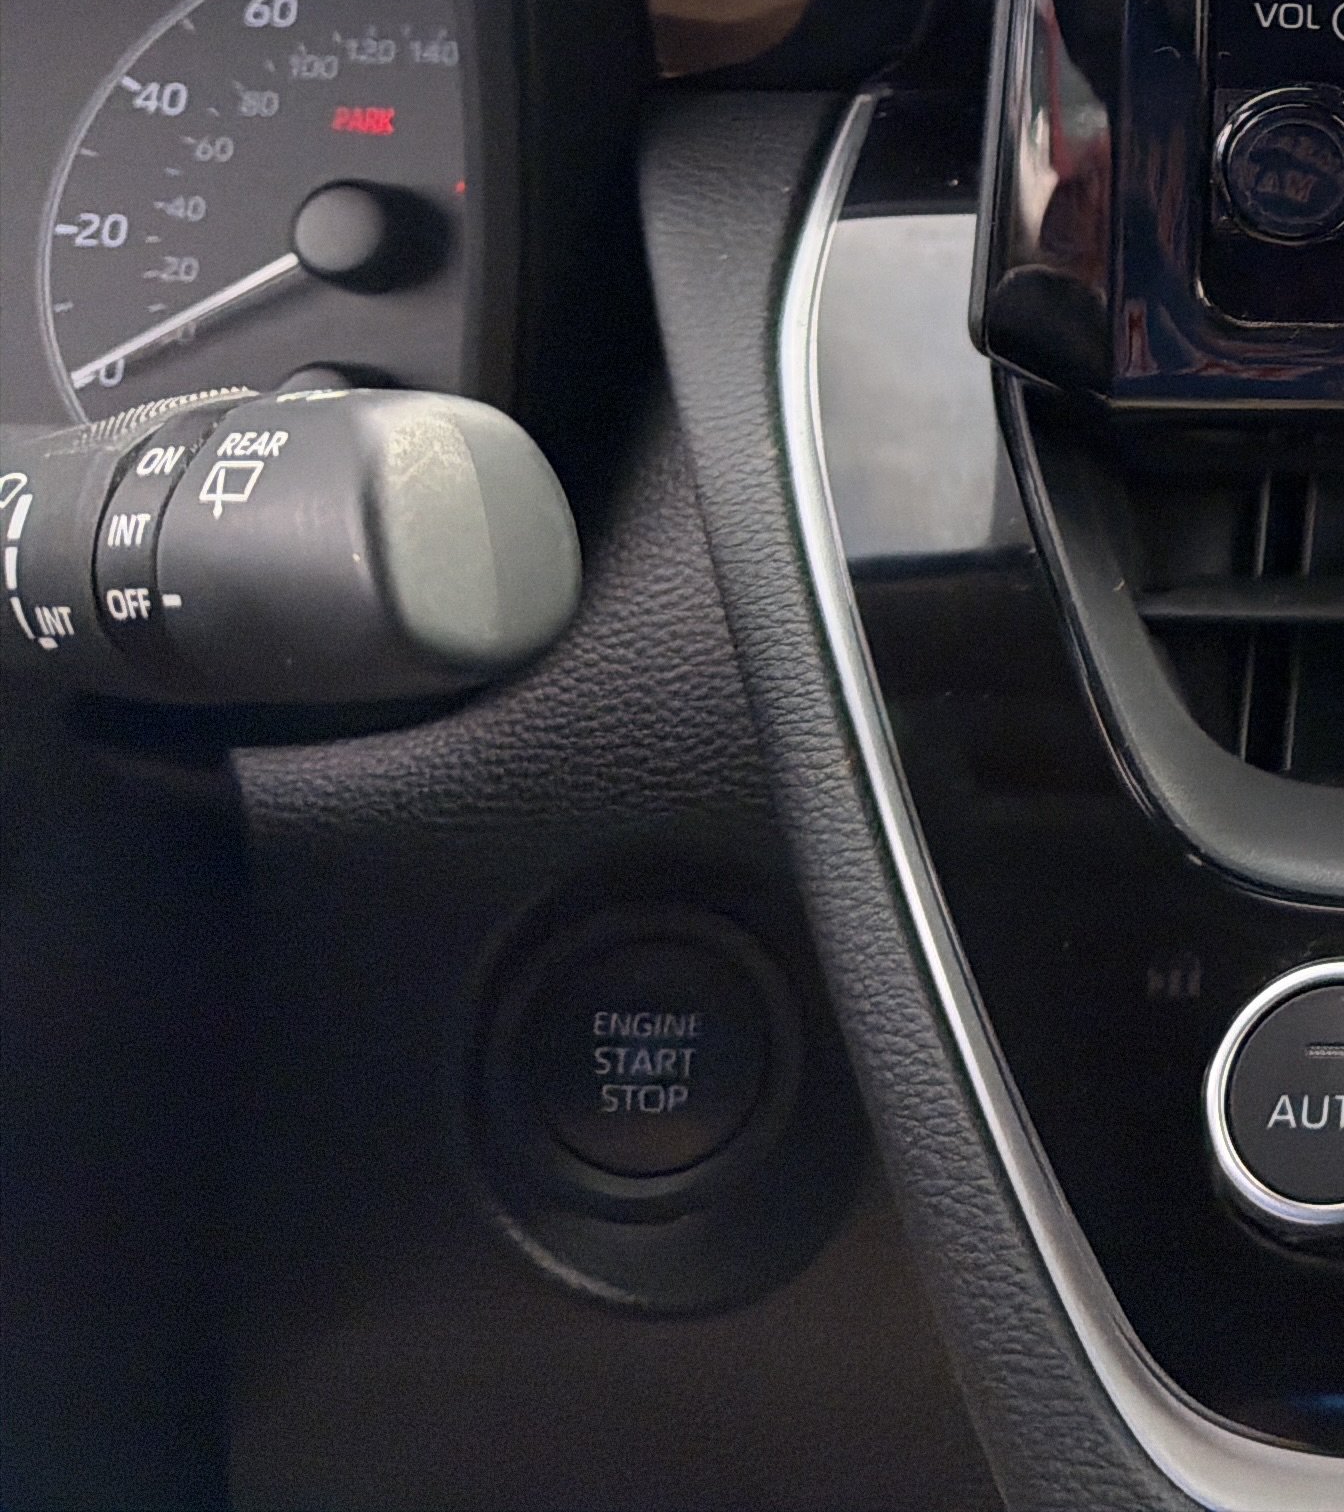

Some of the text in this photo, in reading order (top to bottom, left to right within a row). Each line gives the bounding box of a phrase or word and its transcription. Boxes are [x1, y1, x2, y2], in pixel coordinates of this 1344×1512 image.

[1254, 2, 1320, 30] VOL
[344, 38, 396, 65] 120
[410, 40, 459, 67] 140
[289, 53, 339, 80] 100
[133, 81, 189, 117] 40
[331, 106, 395, 135] PARK
[194, 136, 235, 163] 60
[163, 194, 207, 222] 40
[73, 212, 129, 248] 20
[160, 255, 200, 283] 20
[217, 431, 289, 457] REAR
[136, 446, 186, 476] ON
[107, 513, 152, 547] INT
[106, 588, 151, 620] OFF
[34, 606, 75, 636] INT
[592, 1011, 700, 1037] ENGINE
[594, 1046, 696, 1077] START
[600, 1084, 689, 1112] STOP
